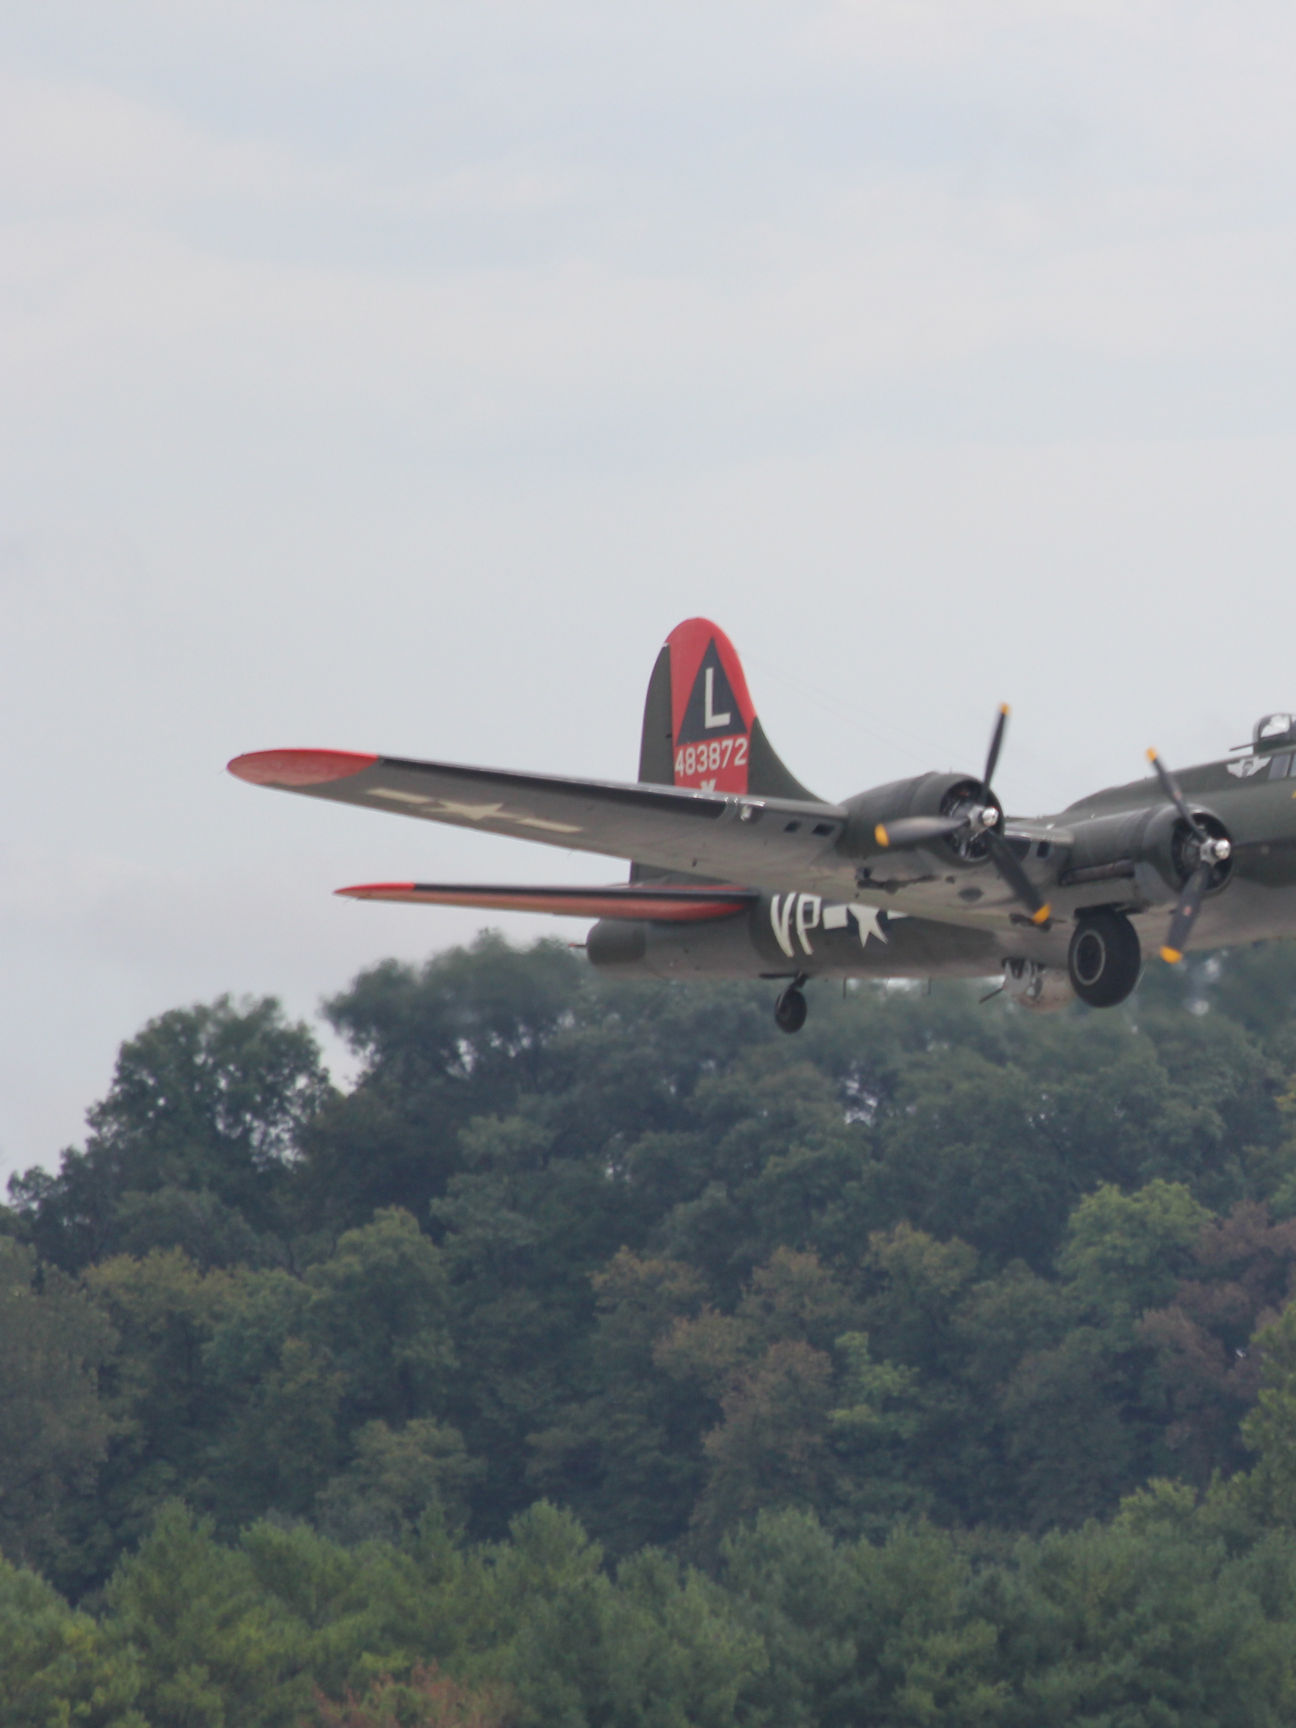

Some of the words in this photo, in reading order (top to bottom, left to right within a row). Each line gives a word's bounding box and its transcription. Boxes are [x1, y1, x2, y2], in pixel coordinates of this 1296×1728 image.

[705, 667, 731, 729] L
[675, 737, 748, 777] 483872
[770, 892, 822, 957] VP
